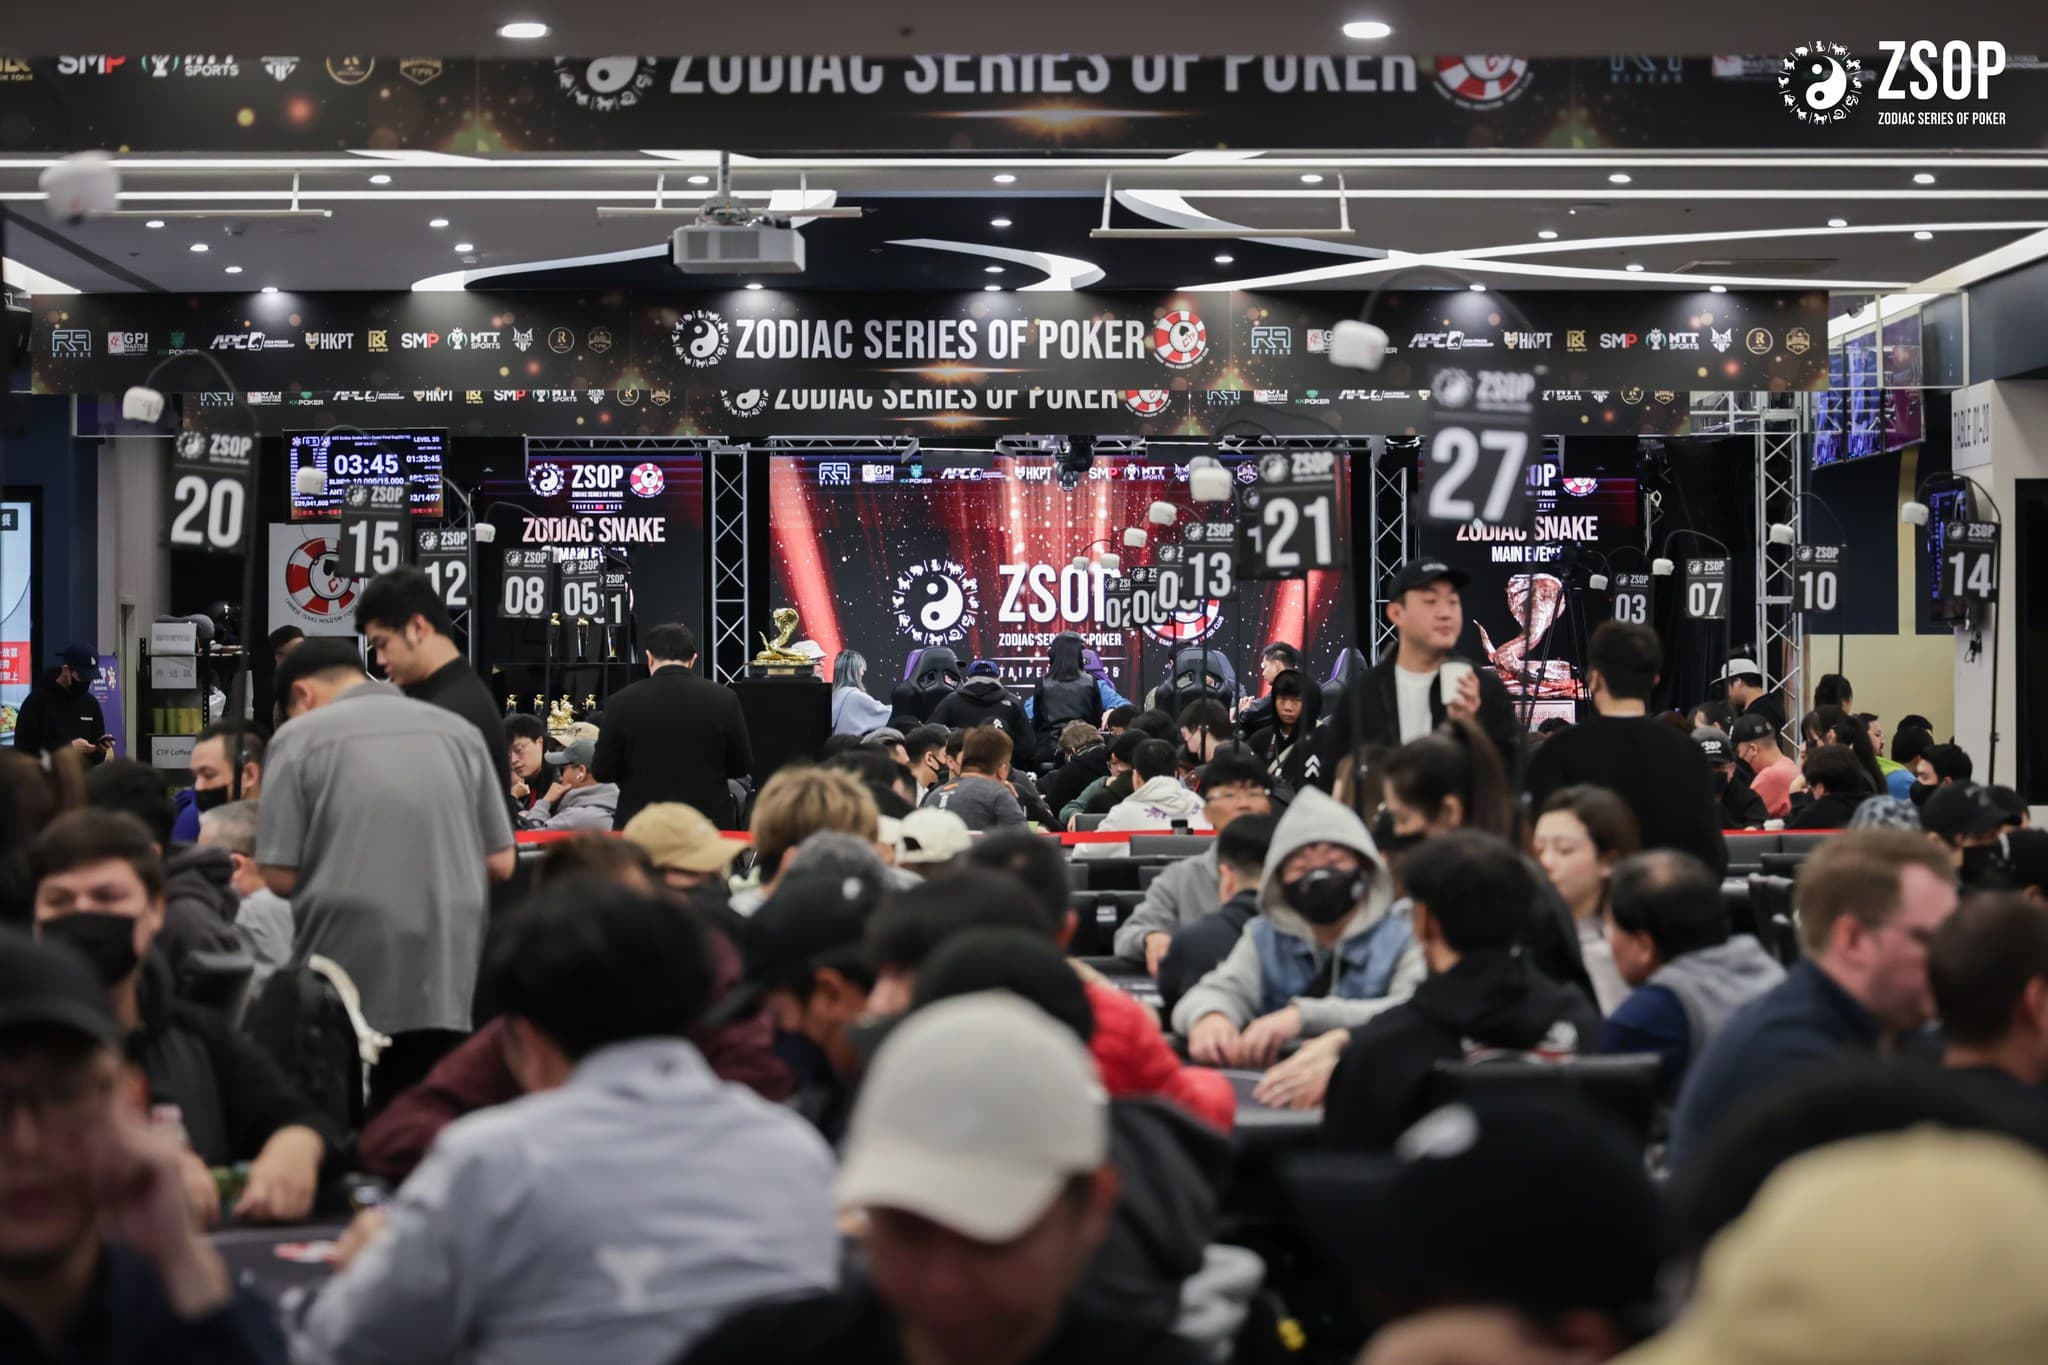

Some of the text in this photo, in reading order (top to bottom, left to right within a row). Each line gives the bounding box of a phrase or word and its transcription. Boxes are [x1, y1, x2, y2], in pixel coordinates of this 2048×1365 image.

[185, 65, 239, 77] SPORTS
[124, 332, 148, 345] GPI
[320, 333, 354, 349] HKPT
[401, 332, 439, 349] SMP
[470, 332, 500, 342] MTT
[735, 319, 853, 359] ZODIAC
[864, 319, 978, 359] SERIES
[988, 319, 1028, 359] OF
[1039, 319, 1145, 359] POKER
[1519, 332, 1552, 349] HKPT
[1600, 333, 1638, 349] SMP
[1669, 332, 1699, 343] MTT
[470, 342, 500, 350] SPORTS
[209, 434, 252, 458] ZSOP
[334, 454, 399, 475] 03:45
[875, 464, 894, 475] GPI
[1142, 466, 1165, 474] MTT
[572, 465, 623, 488] ZSOP
[1026, 466, 1052, 480] HKPT
[1089, 467, 1118, 479] SMP
[1428, 426, 1528, 521] 27
[371, 486, 404, 503] ZSOP
[171, 475, 245, 548] 20
[523, 518, 666, 543] ZODIAC SNAKE
[1206, 523, 1234, 537] ZSOP
[1263, 497, 1332, 567] 21
[1534, 516, 1599, 541] SNAKE
[1967, 523, 1996, 538] ZSOP
[440, 532, 467, 545] ZSOP
[348, 520, 400, 575] 15
[1491, 546, 1522, 562] MAIN
[1815, 546, 1839, 559] ZSOP
[524, 551, 548, 564] ZSOP
[578, 560, 599, 571] ZSOP
[1704, 560, 1725, 571] ZSOP
[606, 574, 624, 584] ZSOP
[1188, 551, 1232, 597] 13
[1630, 574, 1649, 585] ZSOP
[1949, 551, 1992, 598] 14
[424, 561, 467, 606] 12
[1799, 571, 1837, 610] 10
[505, 576, 545, 615] 08
[564, 582, 598, 616] 05
[1688, 582, 1723, 616] 07
[1615, 593, 1646, 624] 03
[998, 633, 1035, 646] ZODIAC
[1037, 633, 1056, 646] SER
[1089, 633, 1122, 646] POKER
